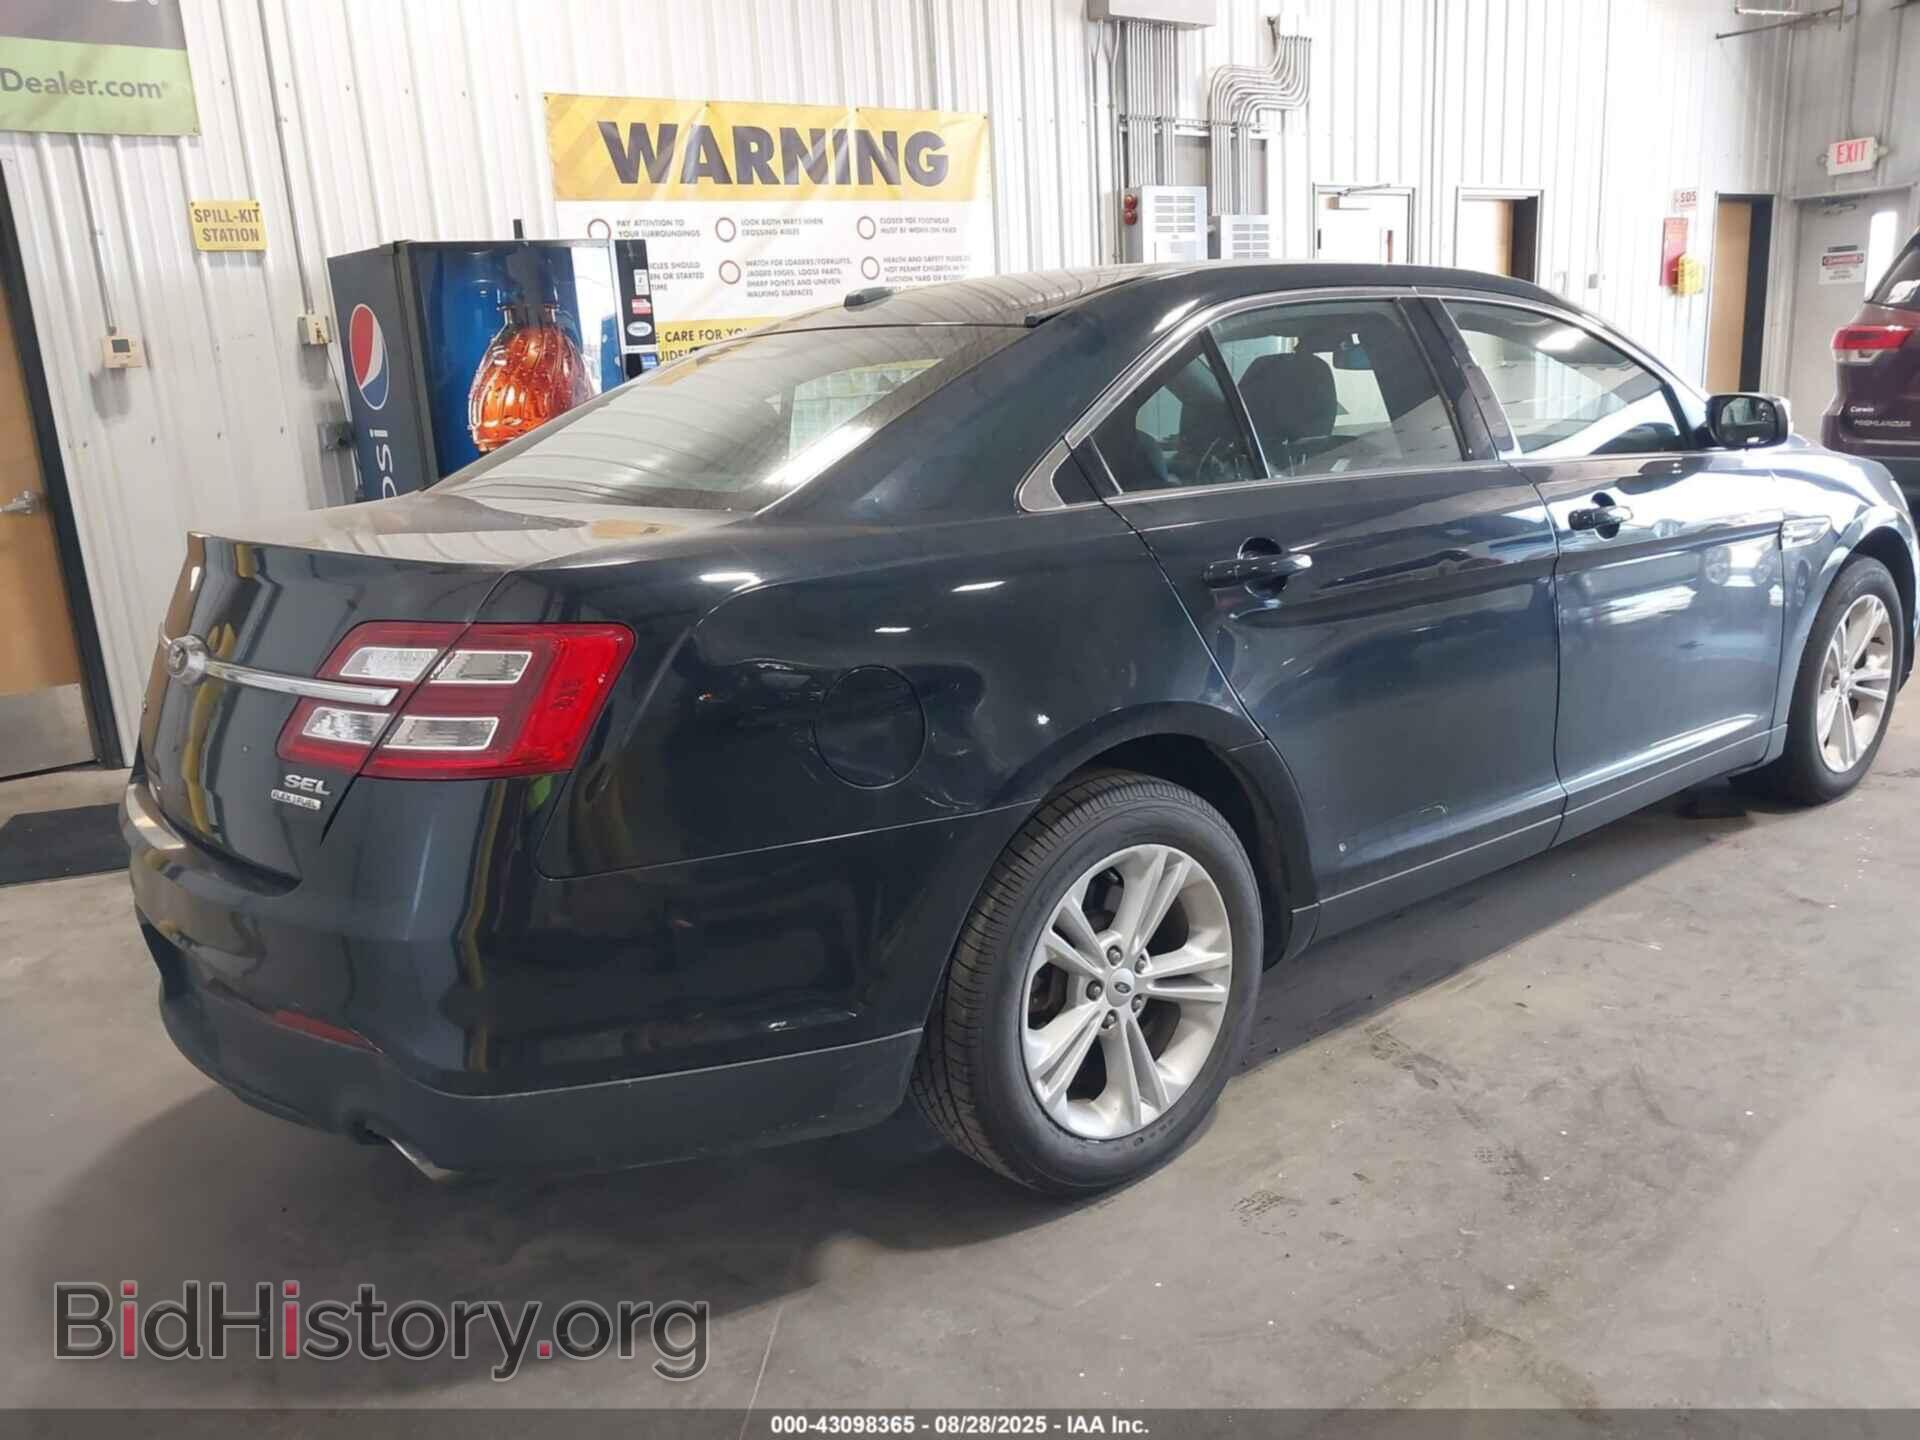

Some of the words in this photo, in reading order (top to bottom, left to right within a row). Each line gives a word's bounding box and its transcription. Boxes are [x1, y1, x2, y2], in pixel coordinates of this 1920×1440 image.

[597, 121, 949, 187] WARNING
[1836, 141, 1867, 165] EXIT
[194, 208, 260, 223] SPILL-KIT
[616, 219, 630, 227] PAY
[633, 218, 673, 227] ATTENTION
[674, 218, 685, 226] TO
[740, 218, 760, 226] LOOK
[202, 228, 260, 242] STATION
[618, 230, 639, 238] YOUR
[641, 229, 701, 238] SURROUNDINGS
[741, 228, 778, 236] CROSSING
[883, 256, 907, 264] HEALTH
[908, 255, 922, 263] AND
[923, 255, 944, 263] SAFETY
[670, 261, 701, 269] SHOULD
[662, 272, 674, 280] OR
[675, 271, 705, 280] STARTED
[798, 268, 820, 276] LOOSE
[650, 283, 668, 291] TIME
[746, 280, 769, 288] SHARP
[770, 279, 796, 287] POINTS
[813, 278, 841, 286] UNEVEN
[746, 290, 780, 298] WALKING
[780, 288, 814, 297] SURFACES
[664, 330, 695, 343] CARE
[698, 329, 723, 341] FOR
[283, 774, 331, 796] SEL
